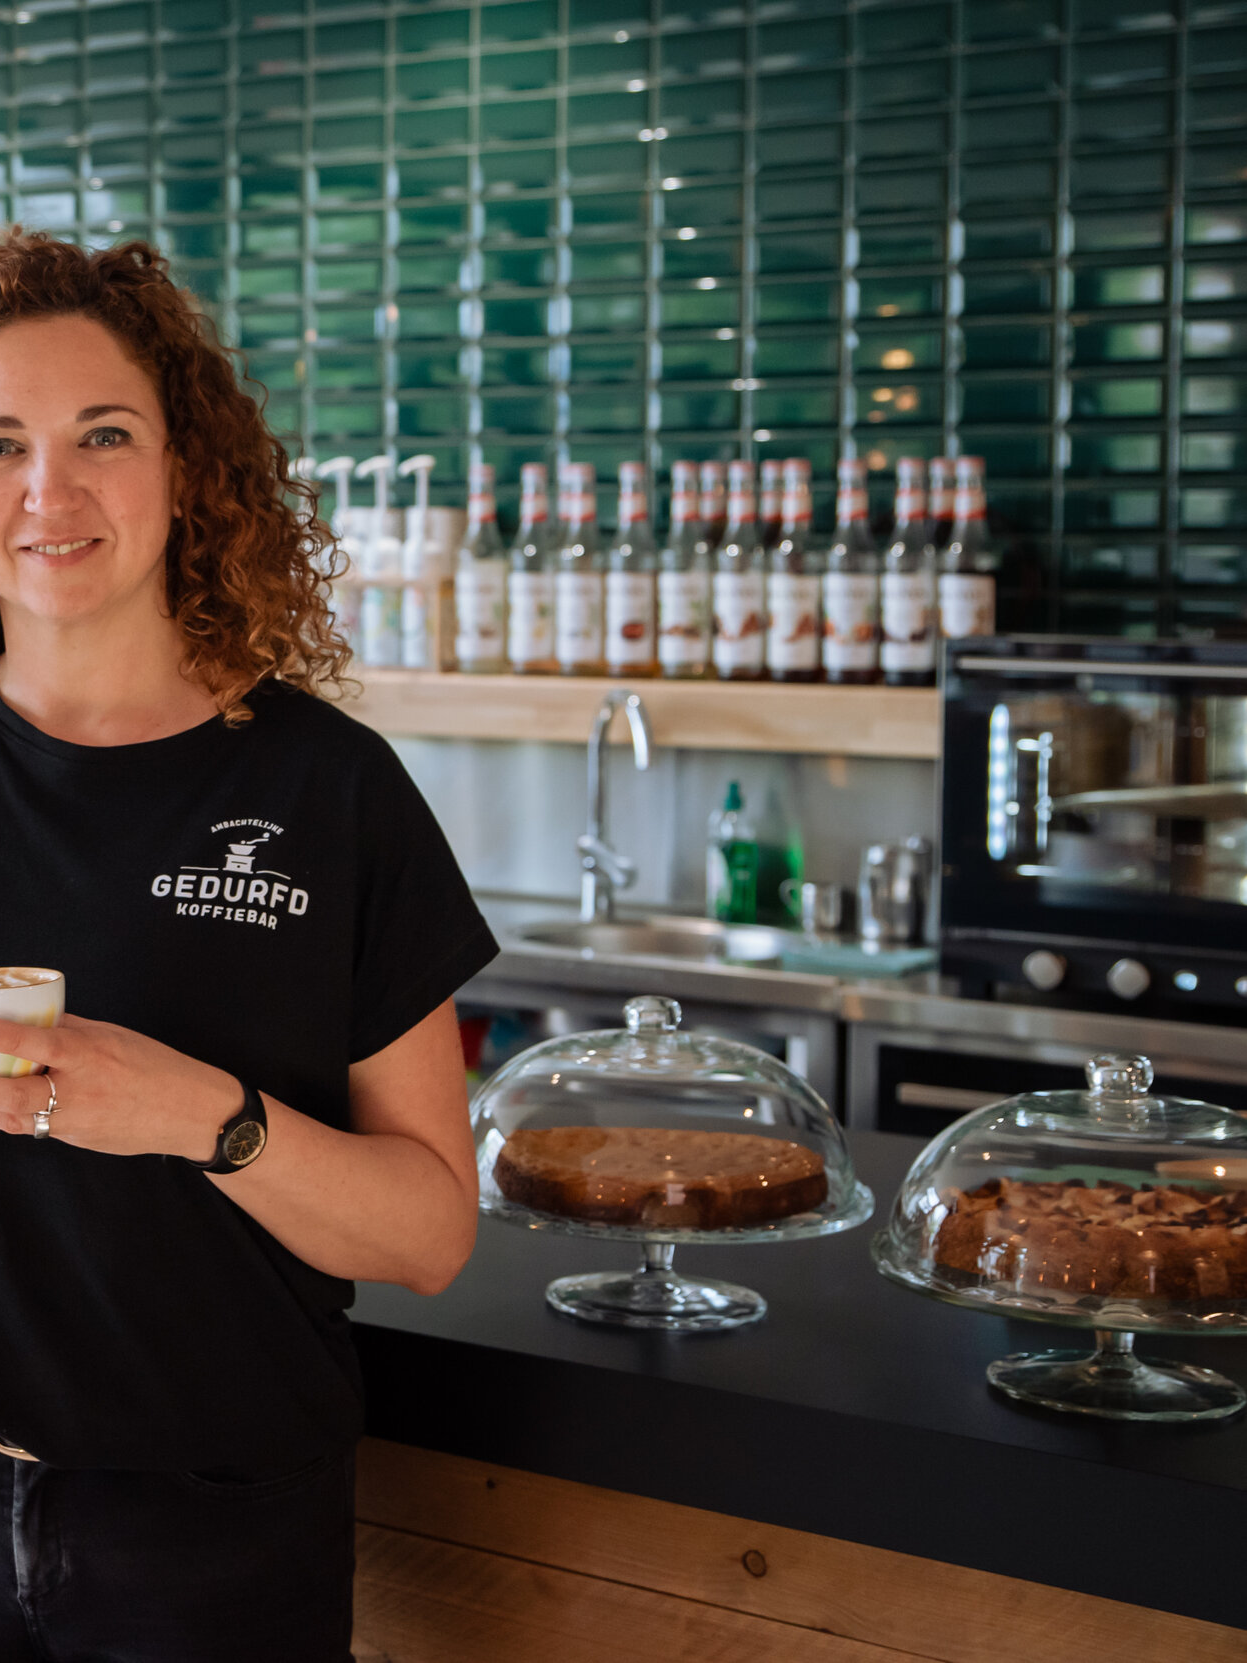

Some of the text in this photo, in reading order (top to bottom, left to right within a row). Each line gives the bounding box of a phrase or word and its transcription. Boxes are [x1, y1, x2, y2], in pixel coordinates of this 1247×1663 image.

[210, 819, 284, 835] AMBACHTELIJKE
[151, 874, 309, 916] GEDURFD
[176, 902, 278, 930] KOFFIEBAR
